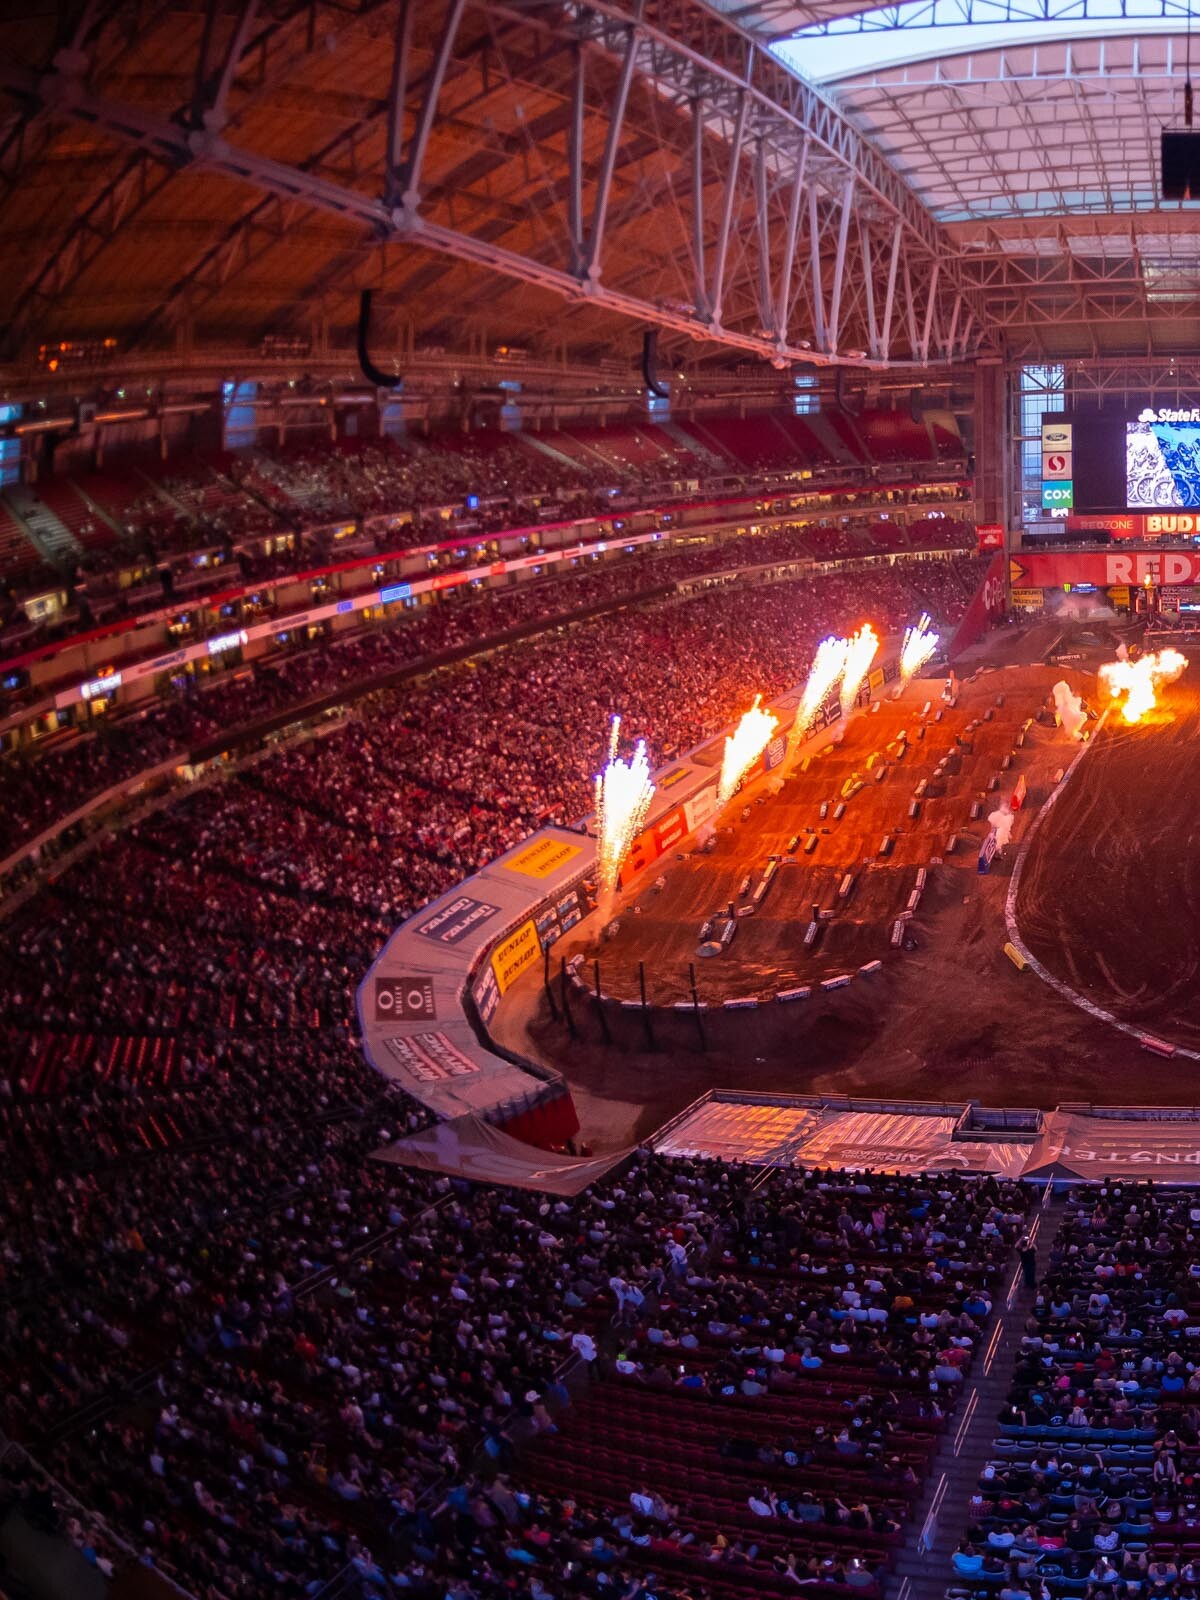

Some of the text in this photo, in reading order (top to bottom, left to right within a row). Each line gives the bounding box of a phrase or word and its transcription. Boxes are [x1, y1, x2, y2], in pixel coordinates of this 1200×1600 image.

[1044, 489, 1071, 500] COX
[1147, 516, 1198, 532] BUD
[420, 898, 471, 935] FALKEN
[441, 904, 491, 942] FALKEN
[498, 928, 532, 963] DUNLOP
[503, 945, 536, 981] DUNLOP
